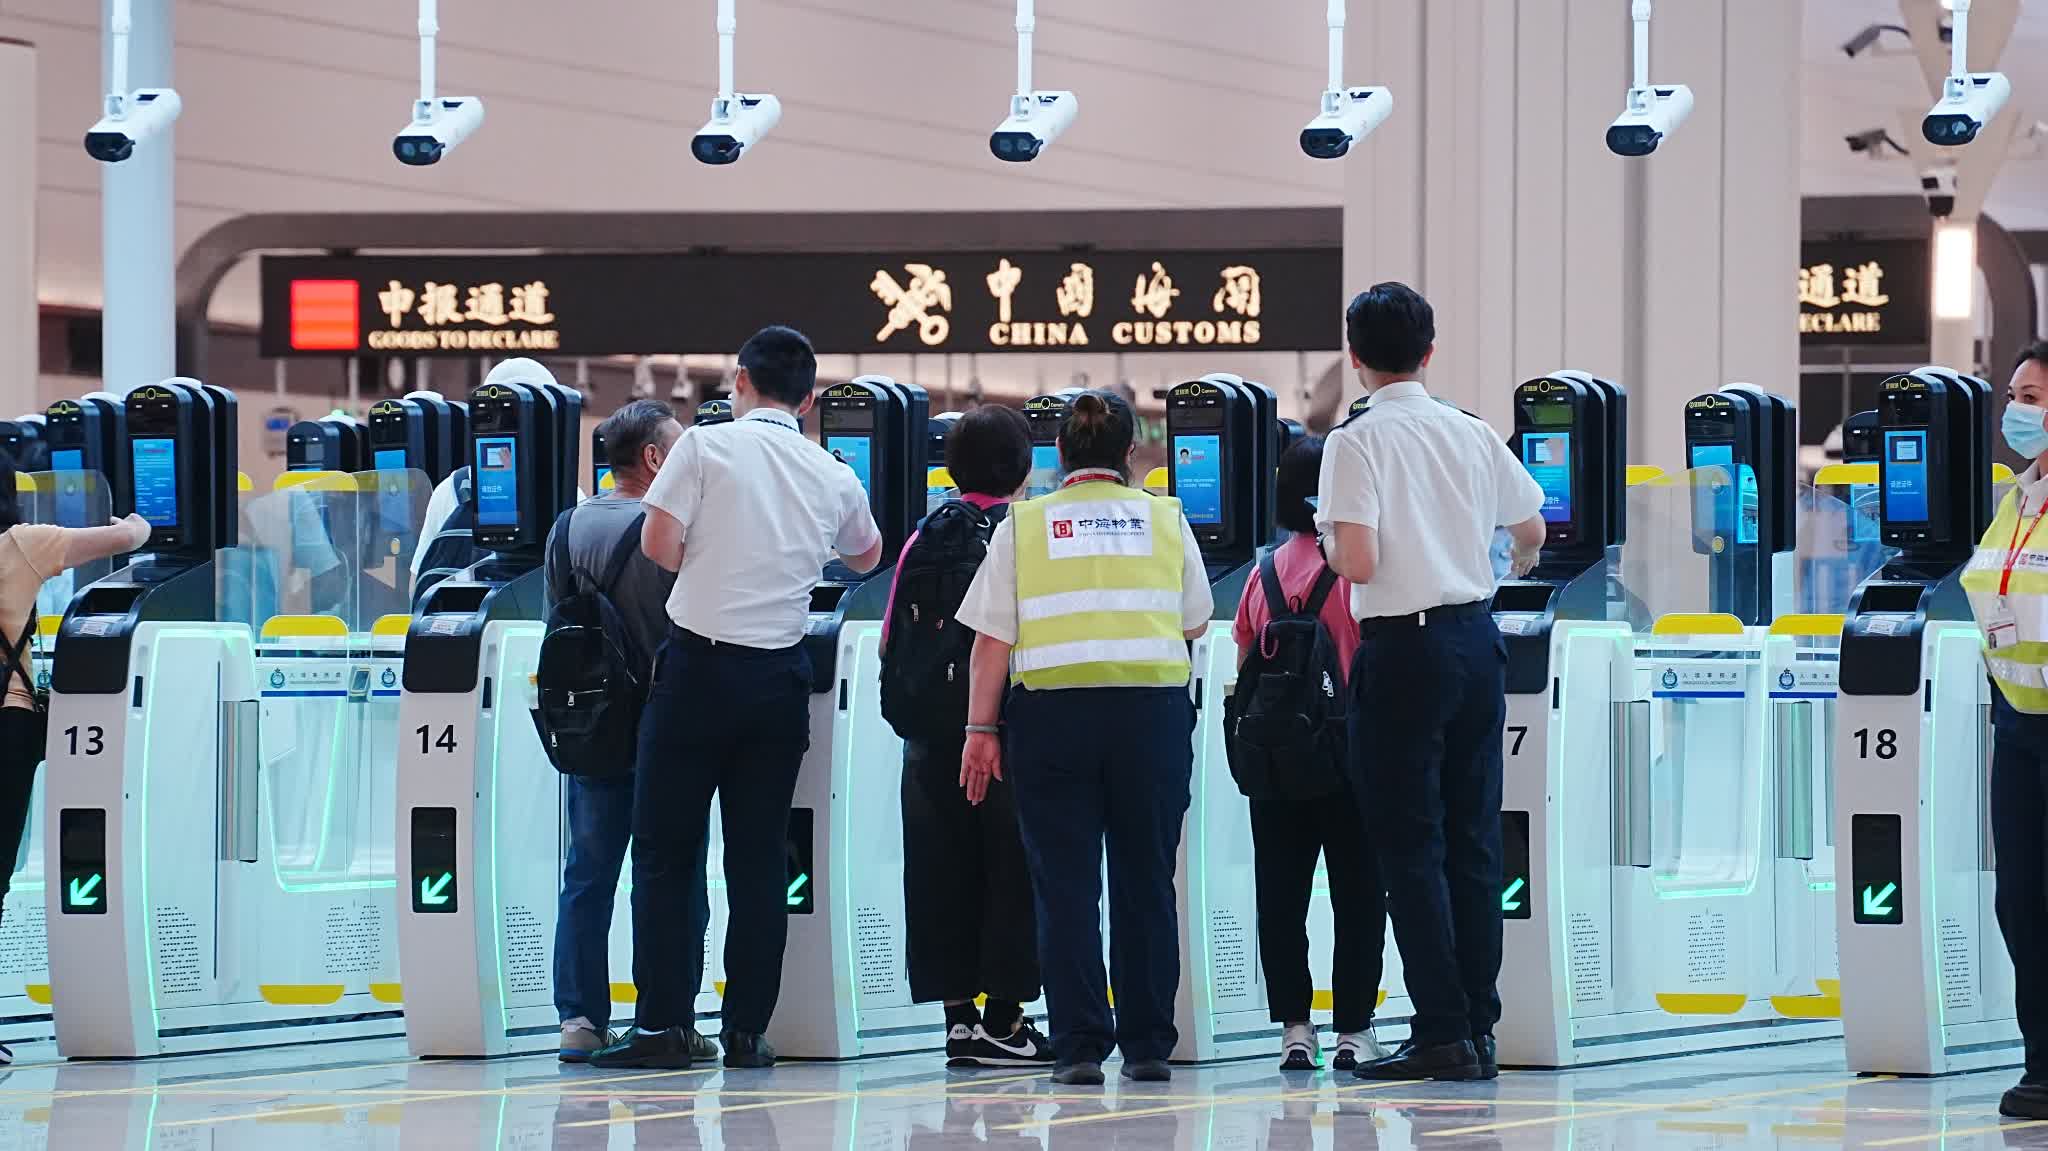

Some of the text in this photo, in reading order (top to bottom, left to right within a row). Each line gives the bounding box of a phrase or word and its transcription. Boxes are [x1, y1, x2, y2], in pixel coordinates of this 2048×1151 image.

[989, 320, 1261, 345] CHINA CUSTOMS
[1800, 312, 1881, 333] ECLARE
[368, 330, 560, 349] GOODS TO DECLARE
[64, 725, 104, 756] 13
[416, 724, 458, 754] 14
[1507, 725, 1528, 756] 7
[1853, 727, 1898, 760] 18
